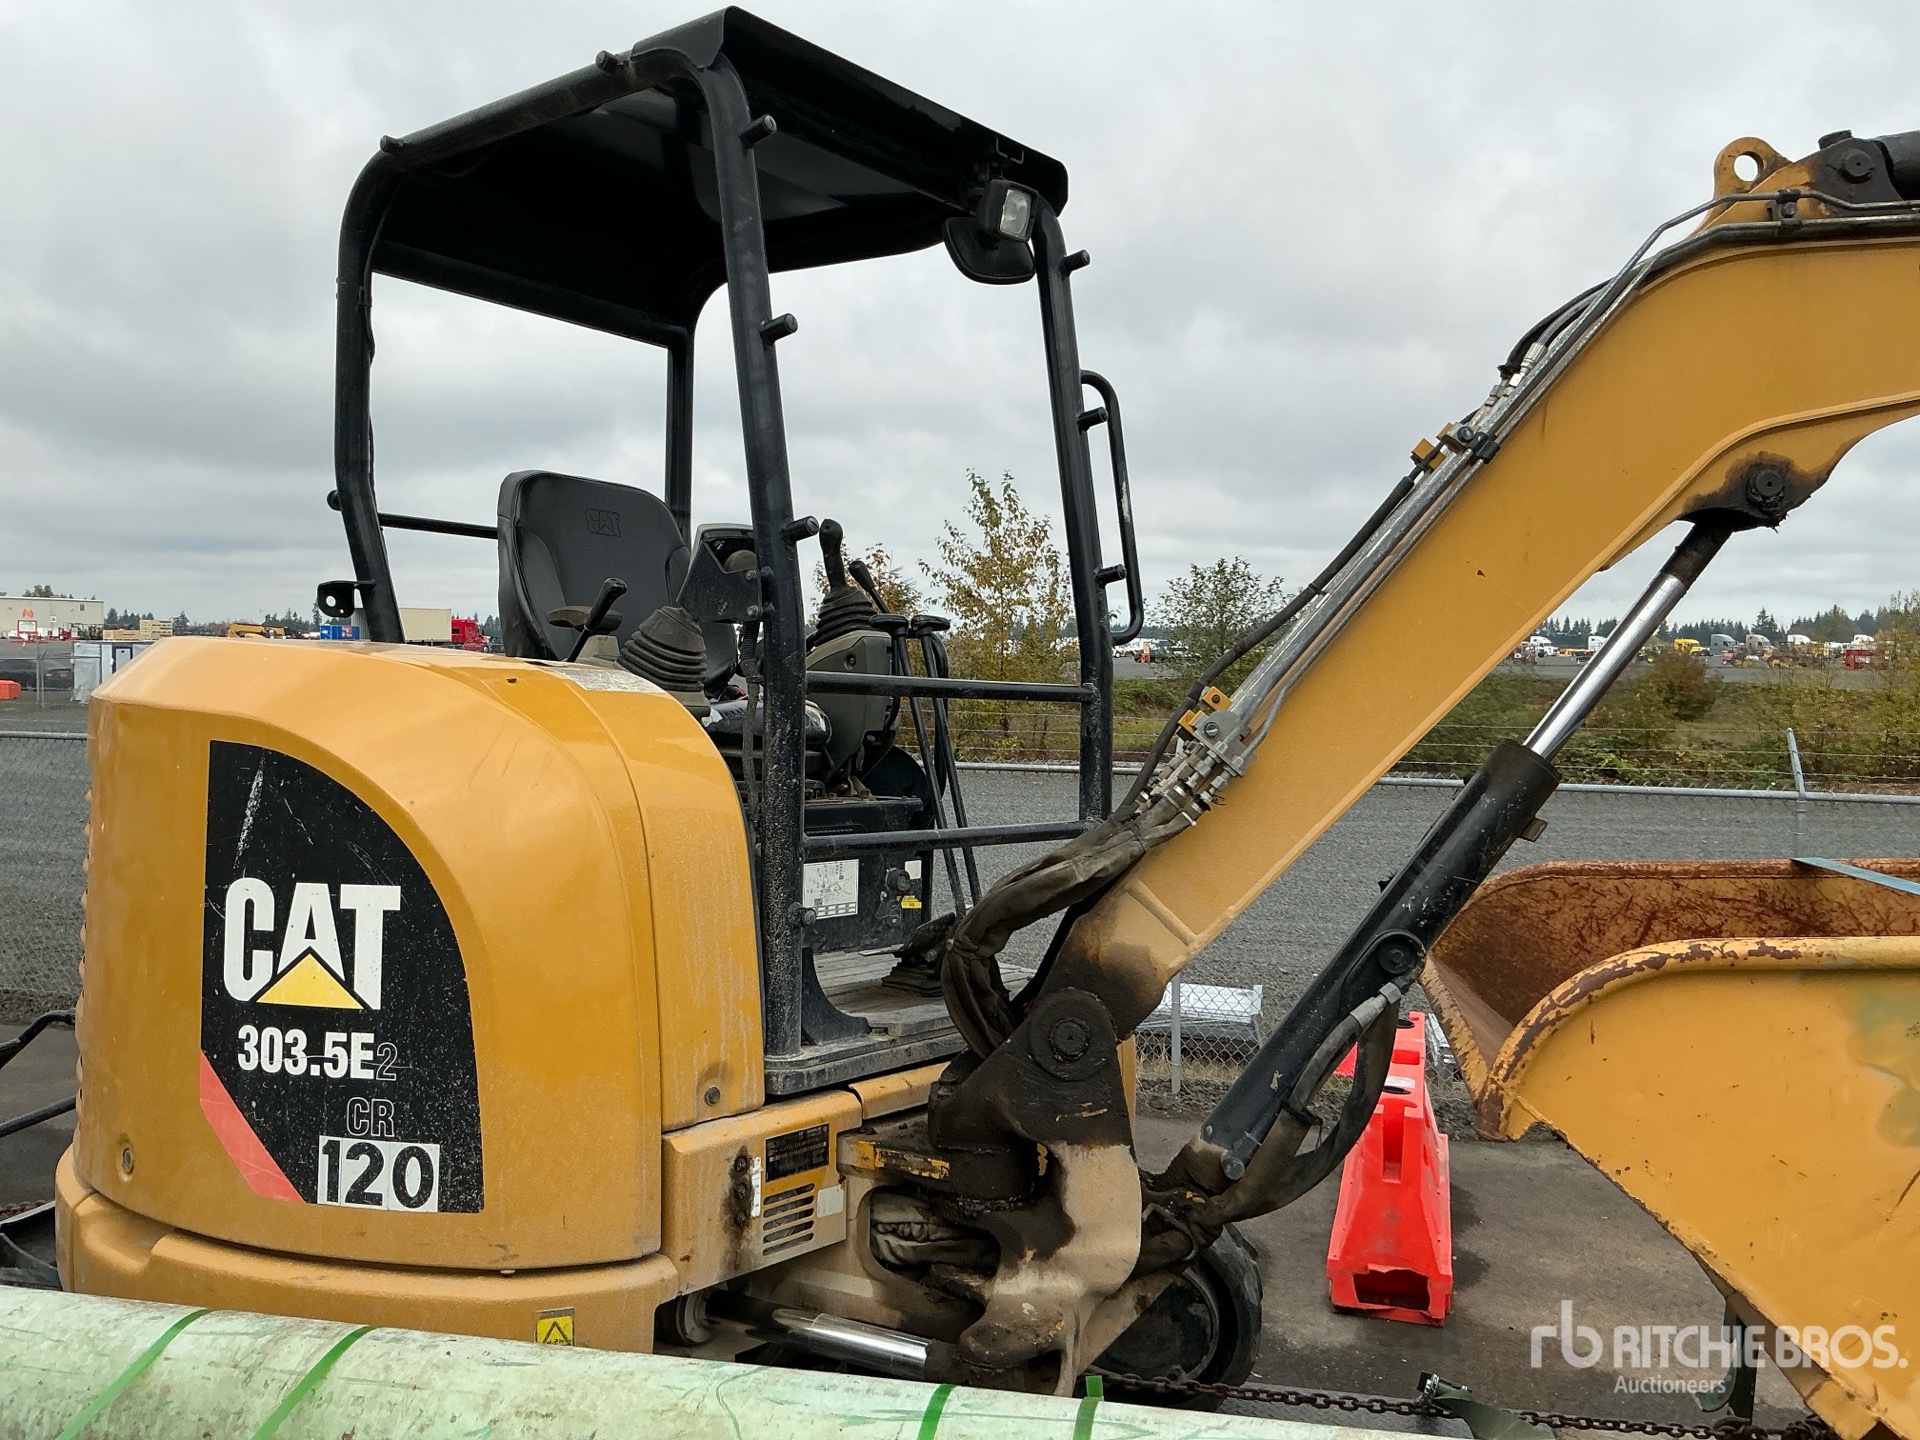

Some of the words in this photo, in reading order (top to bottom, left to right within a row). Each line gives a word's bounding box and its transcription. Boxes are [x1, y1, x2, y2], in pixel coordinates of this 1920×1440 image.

[585, 507, 622, 538] CAT
[223, 877, 401, 1010] CAT
[237, 1025, 397, 1081] 303.5E2
[346, 1096, 395, 1137] CR
[322, 1139, 435, 1210] 120
